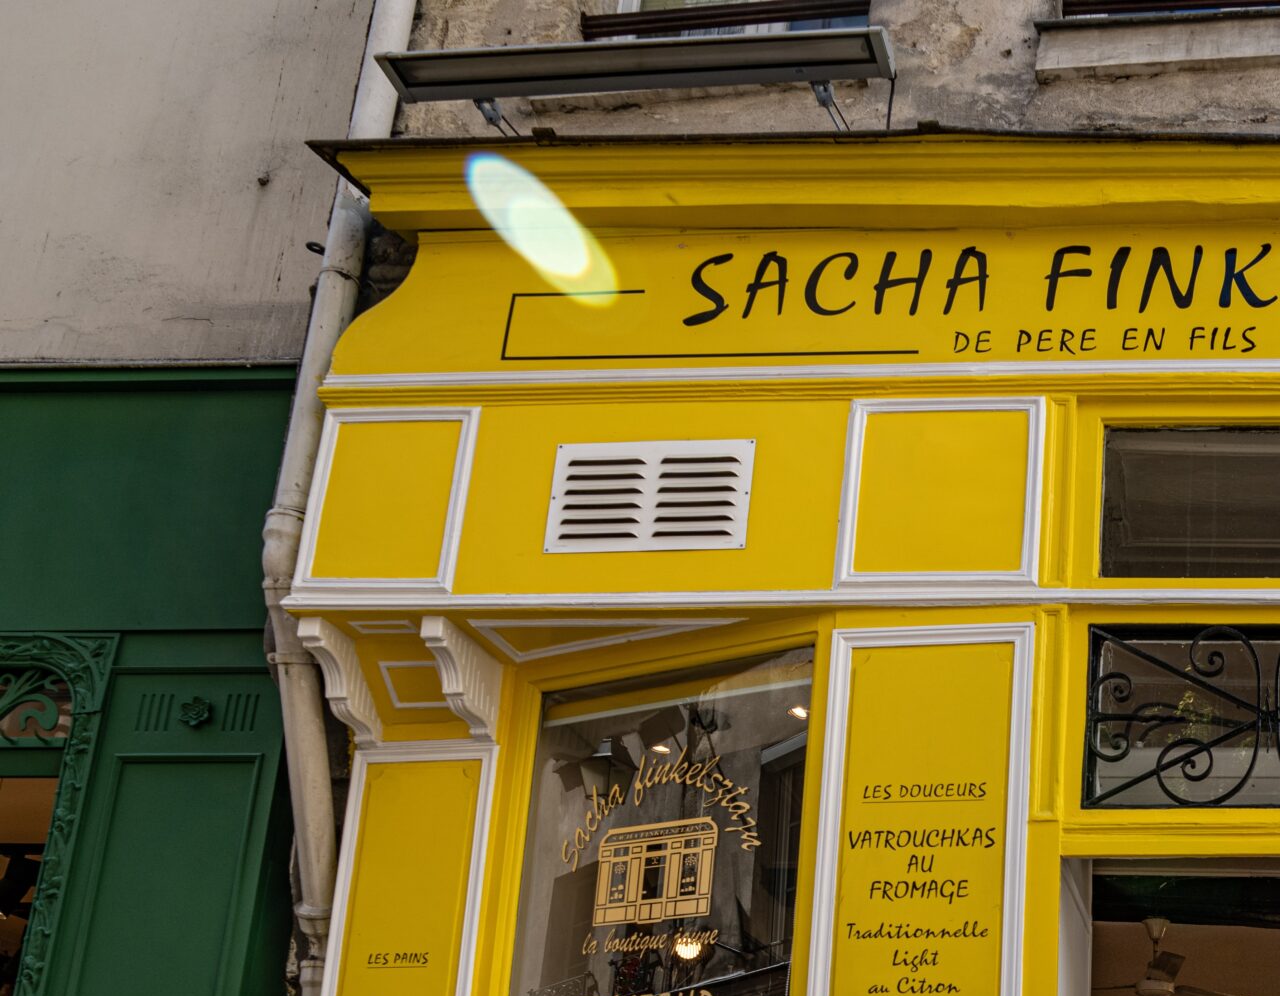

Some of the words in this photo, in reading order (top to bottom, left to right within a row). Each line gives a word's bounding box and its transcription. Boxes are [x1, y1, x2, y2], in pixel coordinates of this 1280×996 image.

[682, 246, 990, 327] SACHA
[952, 329, 992, 354] DE
[1016, 328, 1097, 355] PERE
[1121, 327, 1165, 352] EN
[1188, 326, 1257, 352] FILS
[863, 784, 892, 800] LES
[899, 782, 987, 798] DOUCEURS
[848, 827, 996, 851] VATROUCHKAS
[906, 854, 935, 874] AU
[869, 879, 969, 905] FROMAGE
[604, 928, 666, 957] boutique
[846, 921, 989, 940] Traditionnelle
[368, 952, 389, 966] LES
[393, 951, 429, 965] PAINS
[892, 948, 939, 972] Light
[867, 984, 890, 995] au
[896, 976, 960, 994] Citron
